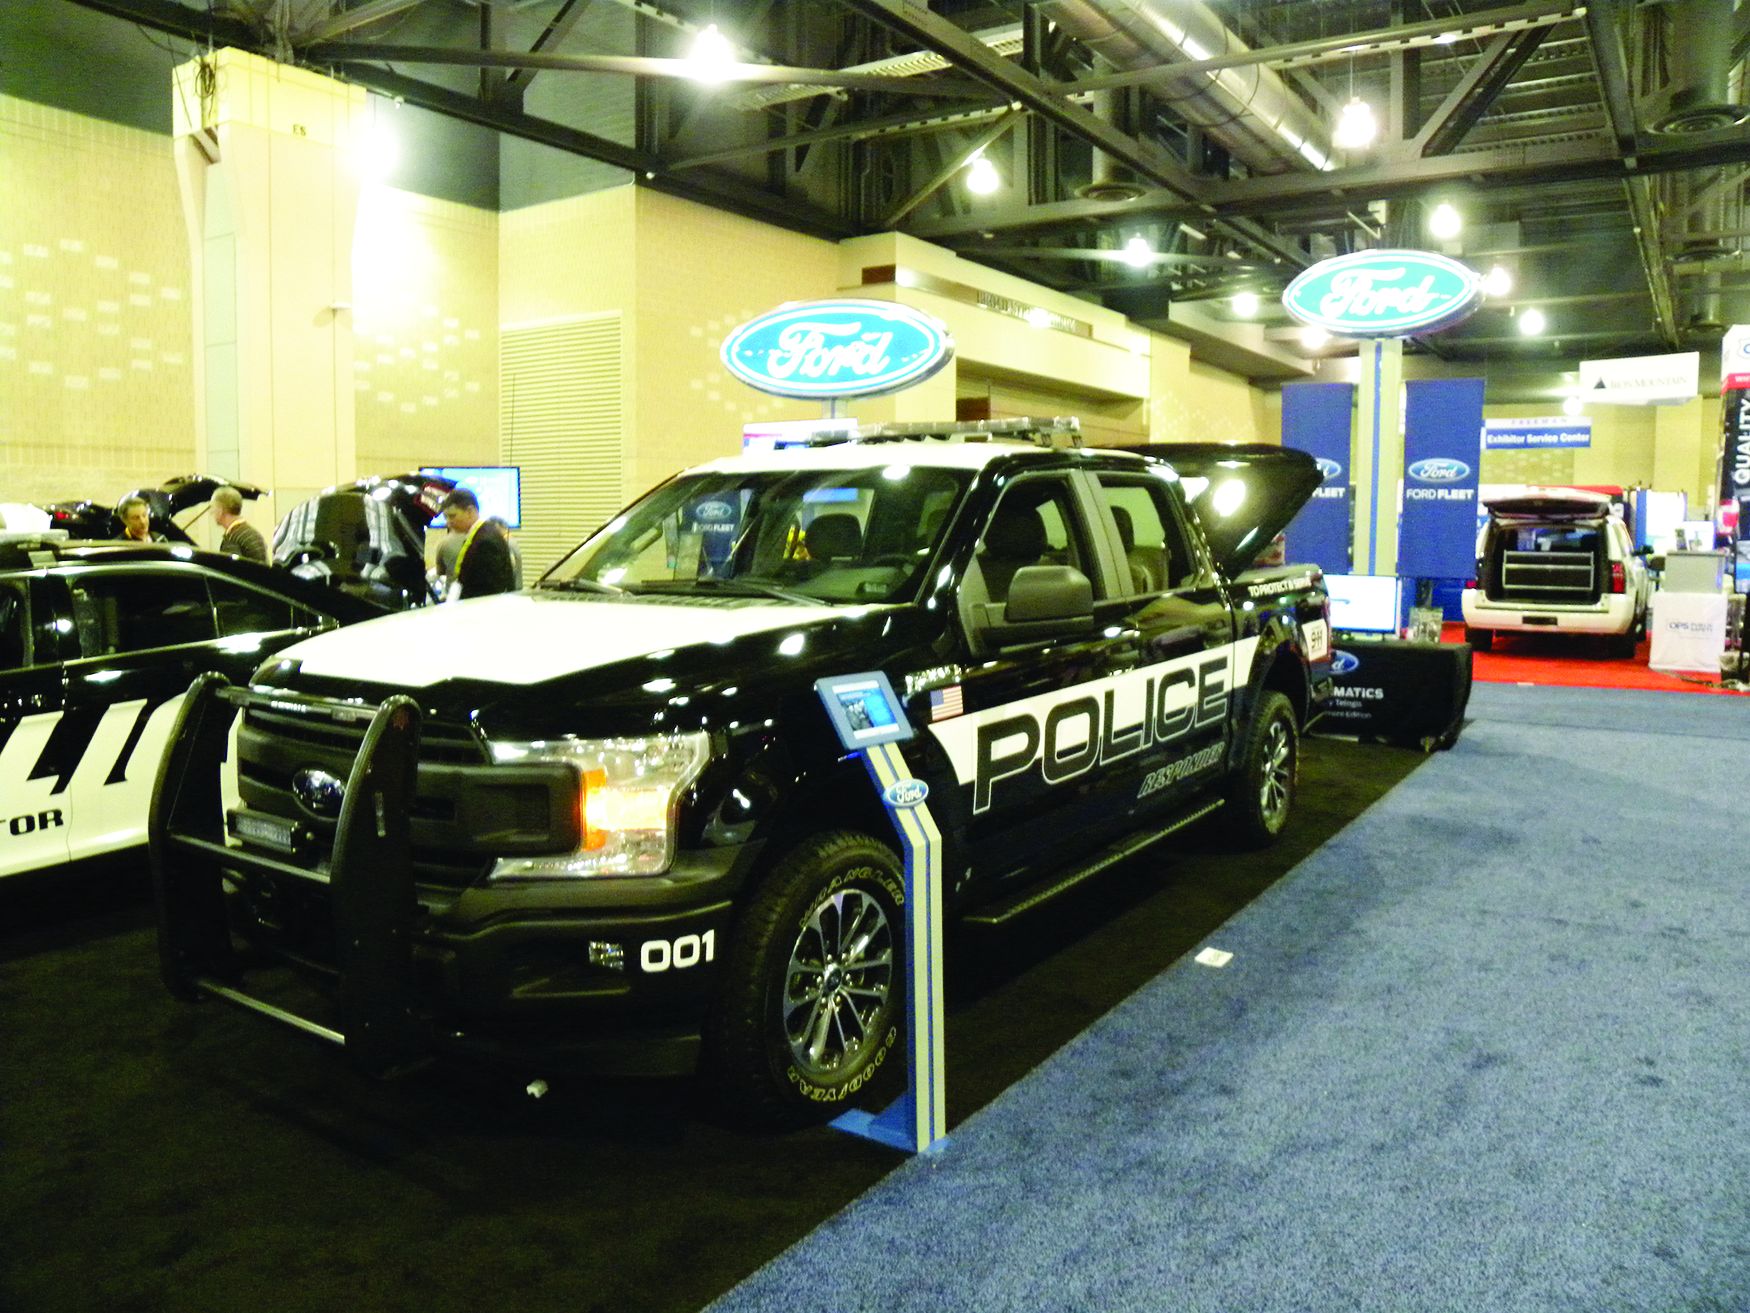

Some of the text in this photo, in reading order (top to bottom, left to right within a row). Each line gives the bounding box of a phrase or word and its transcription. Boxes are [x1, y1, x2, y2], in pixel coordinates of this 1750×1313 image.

[1320, 268, 1436, 319] Ford
[767, 322, 893, 378] Ford
[1487, 432, 1590, 445] Exhibitor Service Center
[1419, 462, 1457, 478] Ford
[1406, 488, 1474, 500] FORD FLEET
[713, 523, 735, 532] FLEET
[1248, 585, 1259, 597] TO
[1259, 581, 1287, 595] PROTECT
[1333, 686, 1385, 700] MATICS
[973, 655, 1229, 816] POLICE
[1137, 741, 1226, 799] RESPONDER
[896, 781, 923, 804] Ford
[0, 808, 65, 836] OR
[640, 928, 715, 973] 001
[786, 1025, 897, 1102] GOODYEAR
